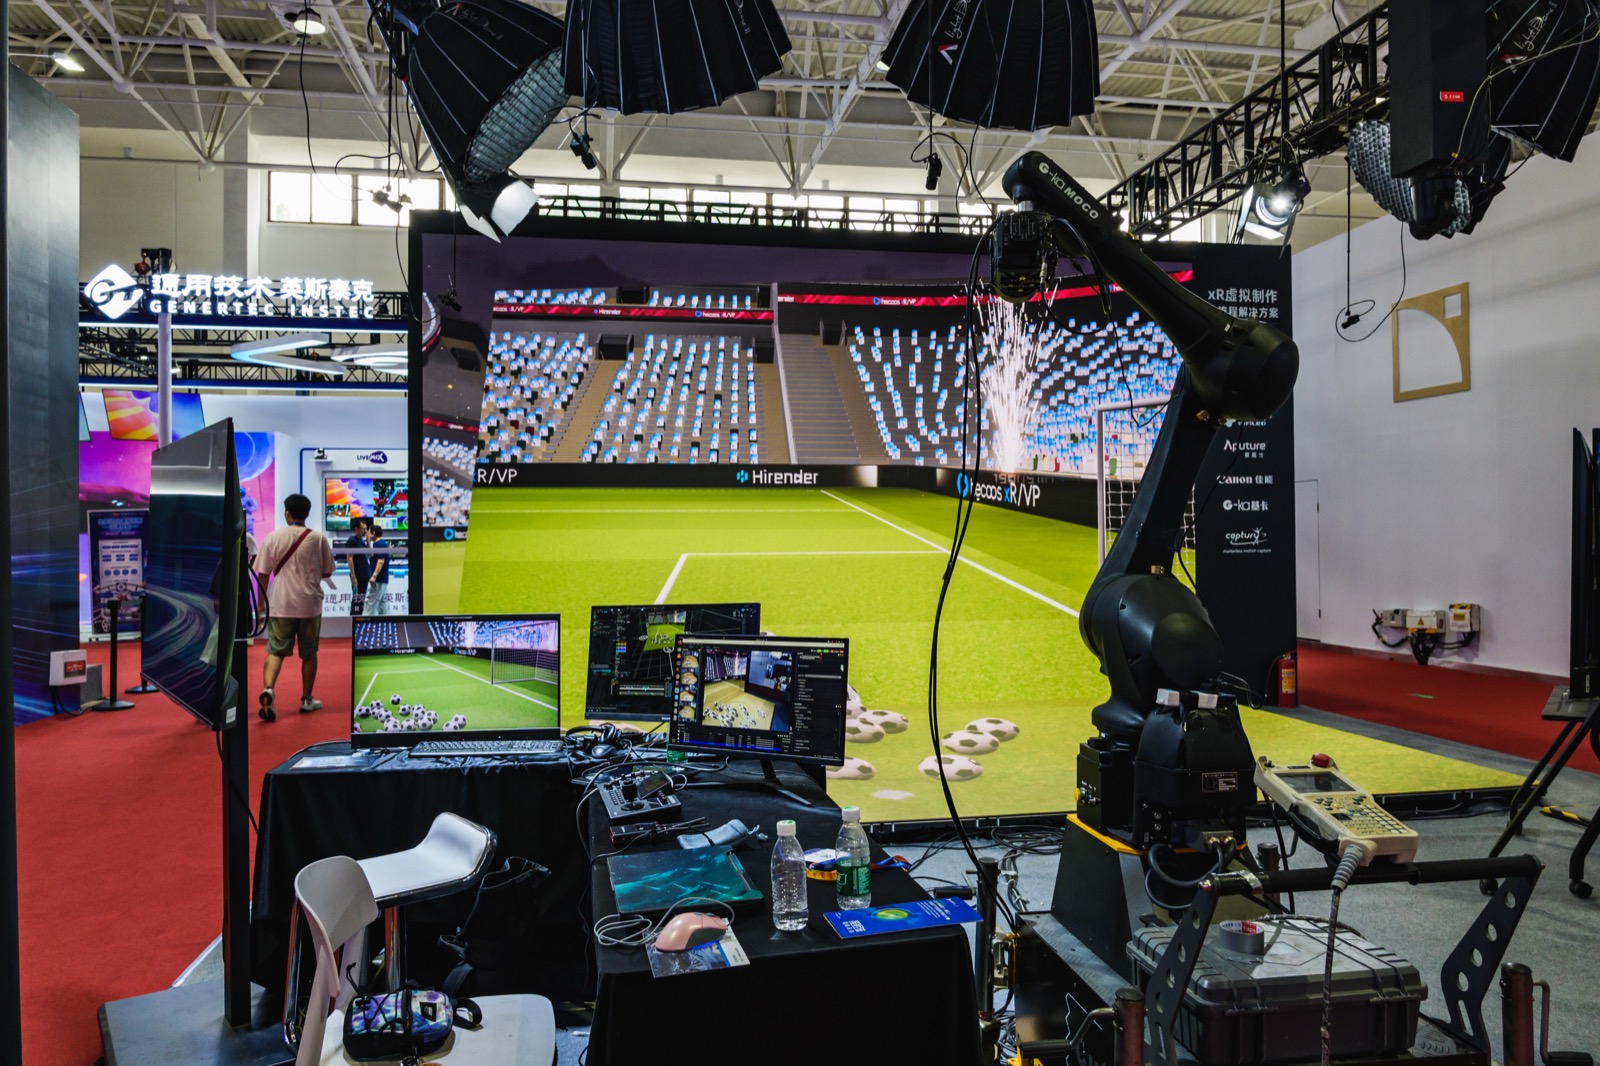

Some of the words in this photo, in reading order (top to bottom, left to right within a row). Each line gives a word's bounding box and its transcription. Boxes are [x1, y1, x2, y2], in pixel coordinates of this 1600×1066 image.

[1063, 186, 1099, 219] MOCO
[151, 273, 276, 299] 通用技术
[279, 276, 375, 301] 英斯泰克
[149, 300, 276, 317] GENERTEC
[289, 303, 375, 319] INSTEC
[752, 469, 819, 485] Hirender
[1216, 474, 1253, 485] Canon
[1003, 482, 1041, 508] xR/VP
